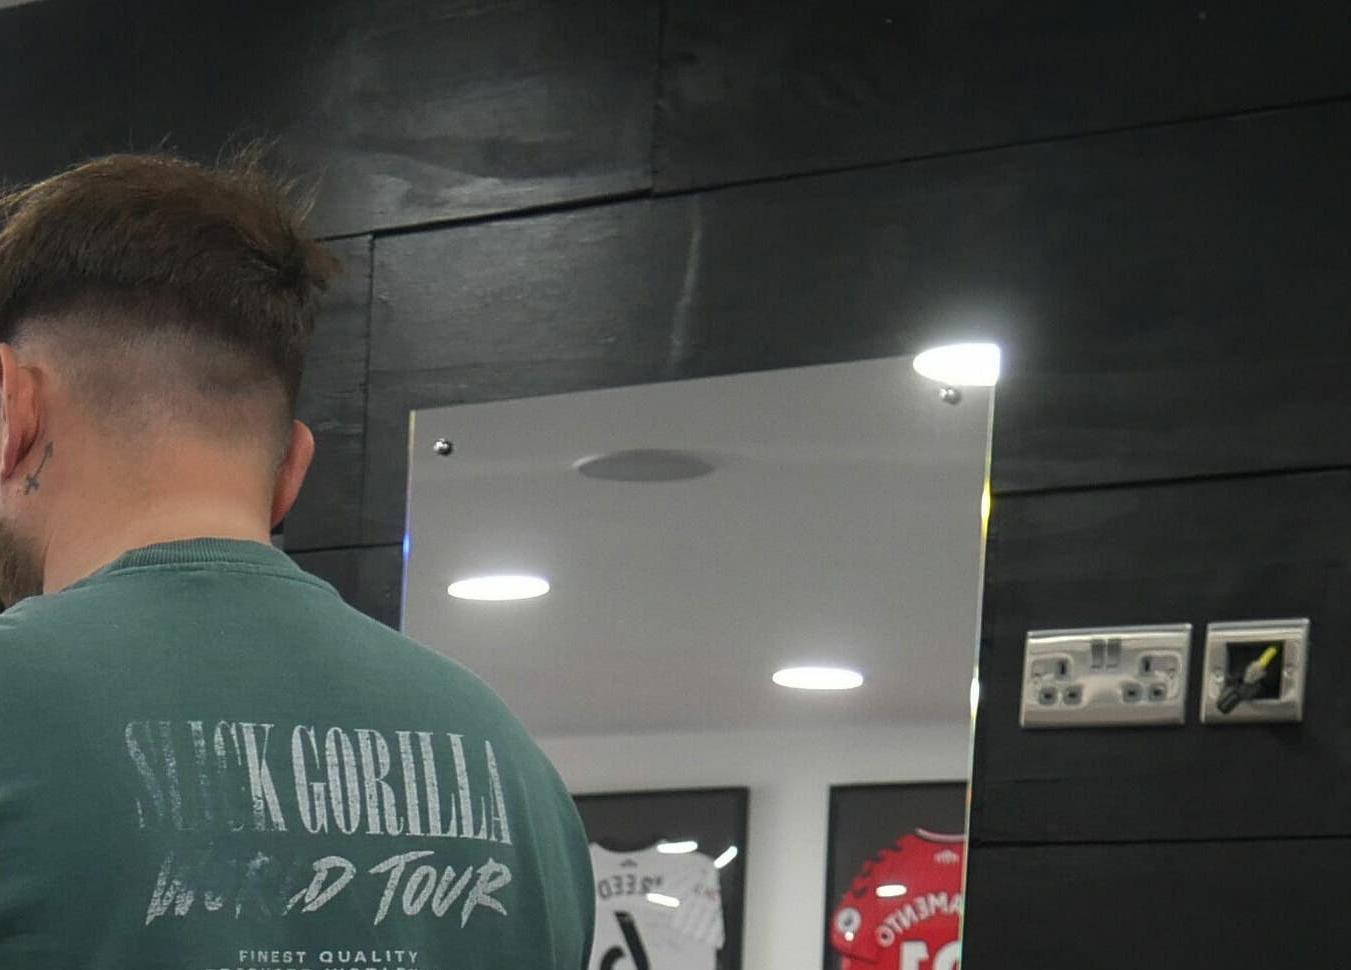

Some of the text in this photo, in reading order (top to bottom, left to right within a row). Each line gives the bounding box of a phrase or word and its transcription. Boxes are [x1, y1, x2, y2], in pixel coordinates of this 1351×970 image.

[291, 724, 513, 846] GORILLA
[144, 850, 513, 929] WLD TOUR
[238, 949, 418, 964] FINEST QUALITY
